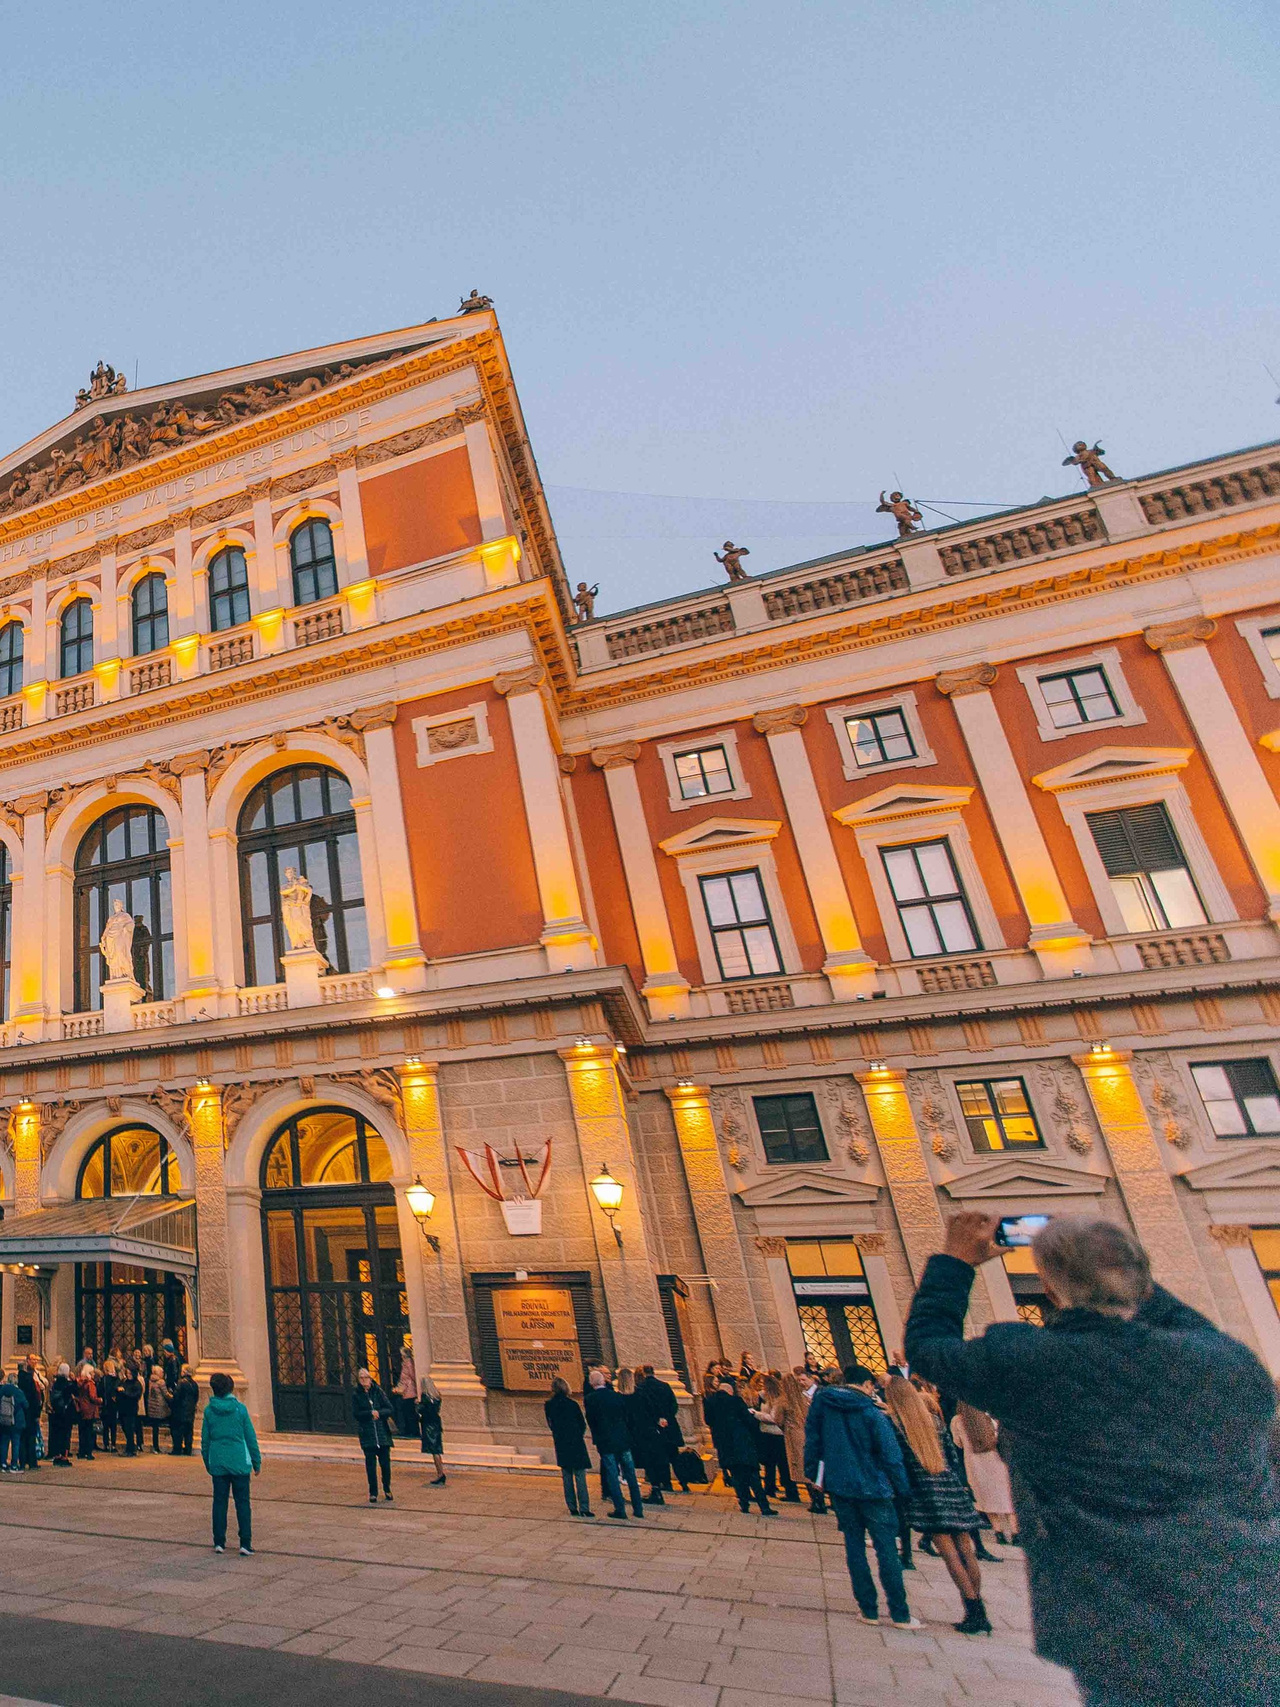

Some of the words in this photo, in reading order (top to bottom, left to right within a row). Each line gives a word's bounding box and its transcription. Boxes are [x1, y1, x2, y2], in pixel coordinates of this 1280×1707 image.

[74, 504, 124, 535] DER
[142, 408, 373, 511] MUSIKFREUNDE
[521, 1302, 549, 1310] ROUVALI
[522, 1362, 535, 1371] SIR
[535, 1362, 560, 1372] SIMON
[528, 1371, 556, 1380] RATTLE
